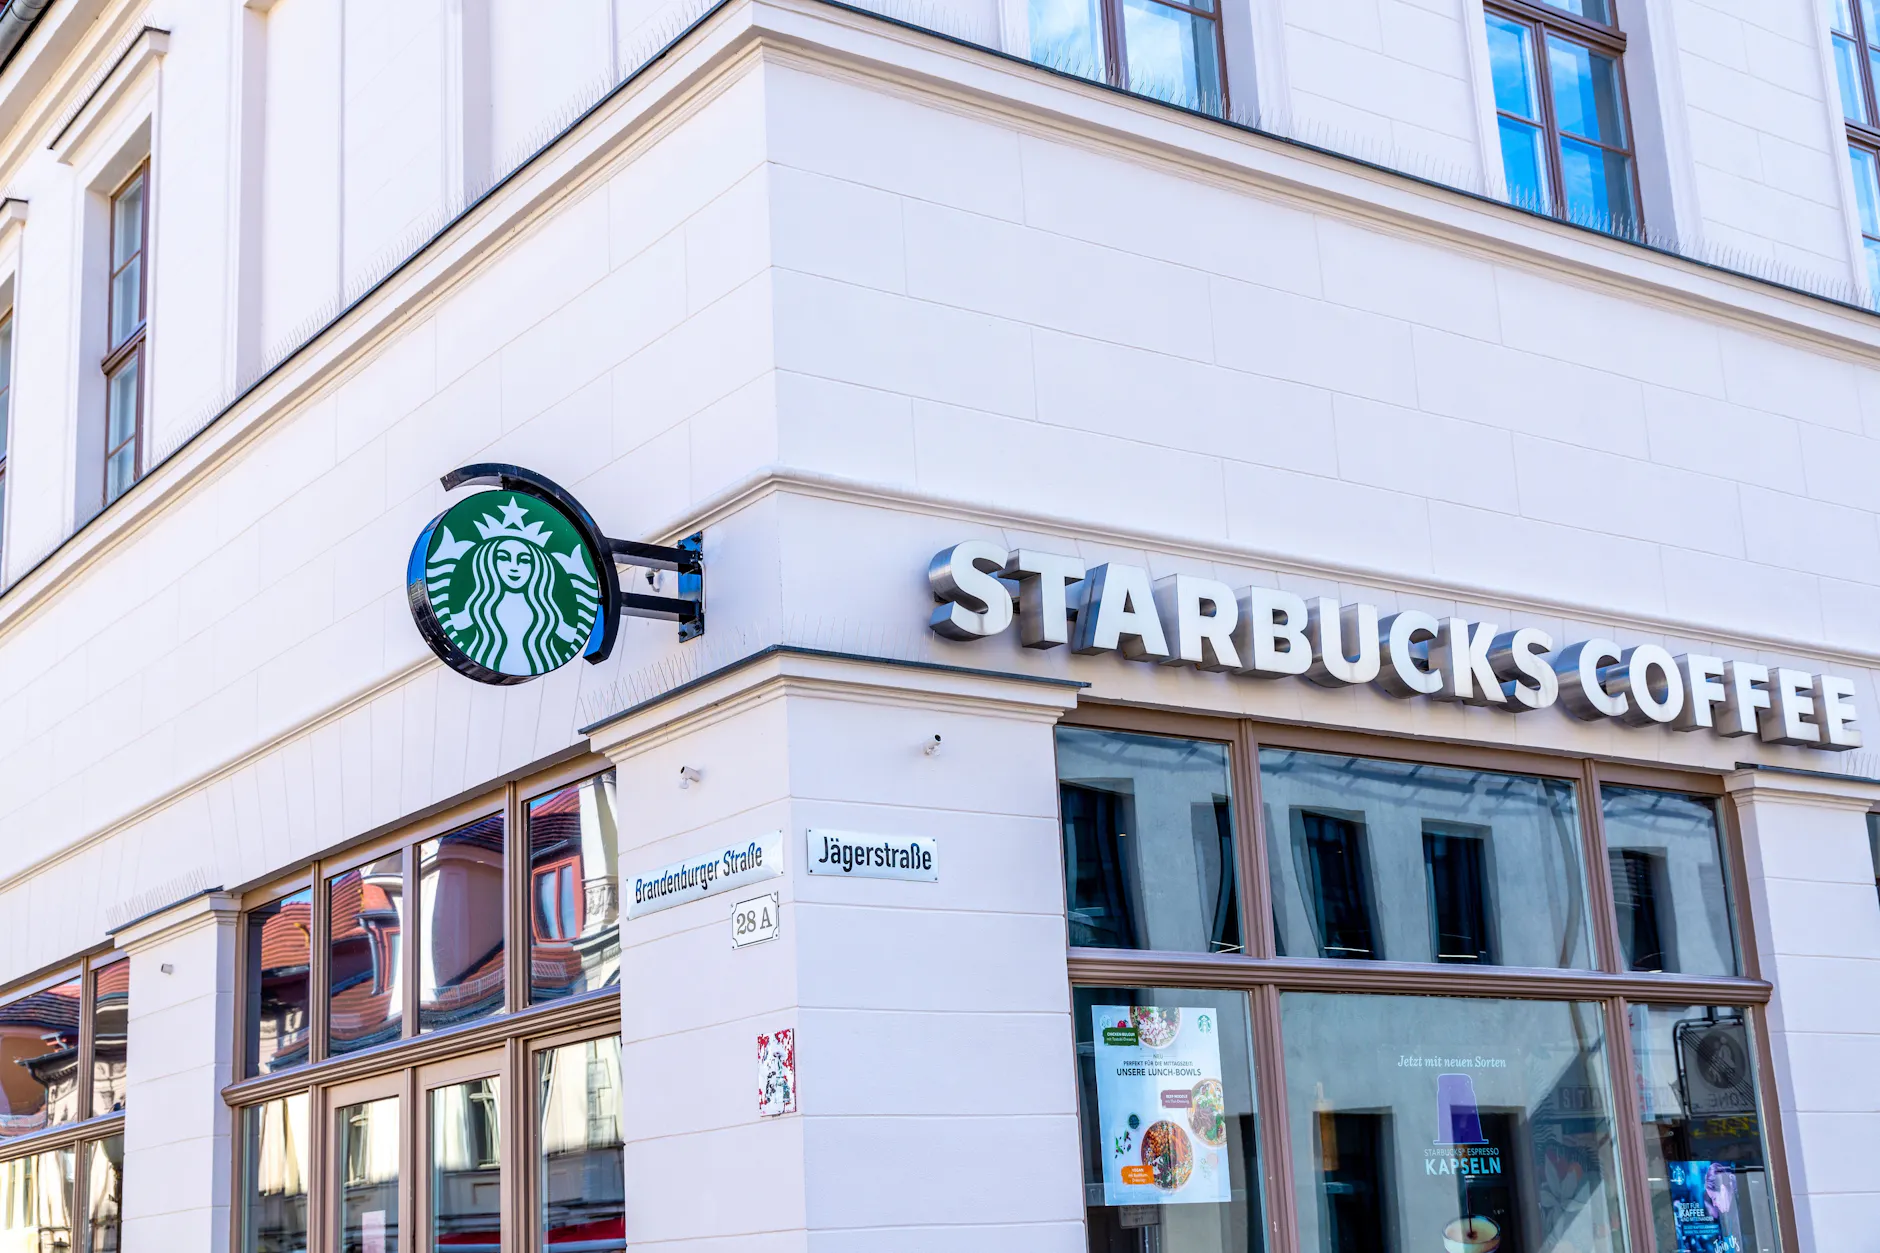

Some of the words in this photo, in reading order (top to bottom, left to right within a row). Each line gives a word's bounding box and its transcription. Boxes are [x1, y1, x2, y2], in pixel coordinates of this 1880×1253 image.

[932, 540, 1559, 712] STARBUCKS
[1558, 638, 1863, 752] COFFEE
[818, 836, 932, 873] Jägerstraße
[635, 858, 720, 904] Brandenburger
[723, 842, 763, 877] Straße
[736, 910, 757, 936] 28
[760, 907, 773, 930] A
[1144, 1059, 1154, 1067] FÜR
[1397, 1055, 1422, 1067] Jetzt
[1424, 1056, 1442, 1067] mit
[1444, 1058, 1473, 1068] neuen
[1474, 1056, 1506, 1068] Sorten
[1116, 1068, 1146, 1076] UNSERE
[1148, 1068, 1202, 1076] LUNCH-BOWLS
[1467, 1147, 1500, 1156] ESPRESSO
[1425, 1157, 1502, 1176] KAPSELN
[1681, 1208, 1705, 1217] KAFFEE
[1713, 1239, 1729, 1253] Join
[1728, 1234, 1740, 1252] Us
